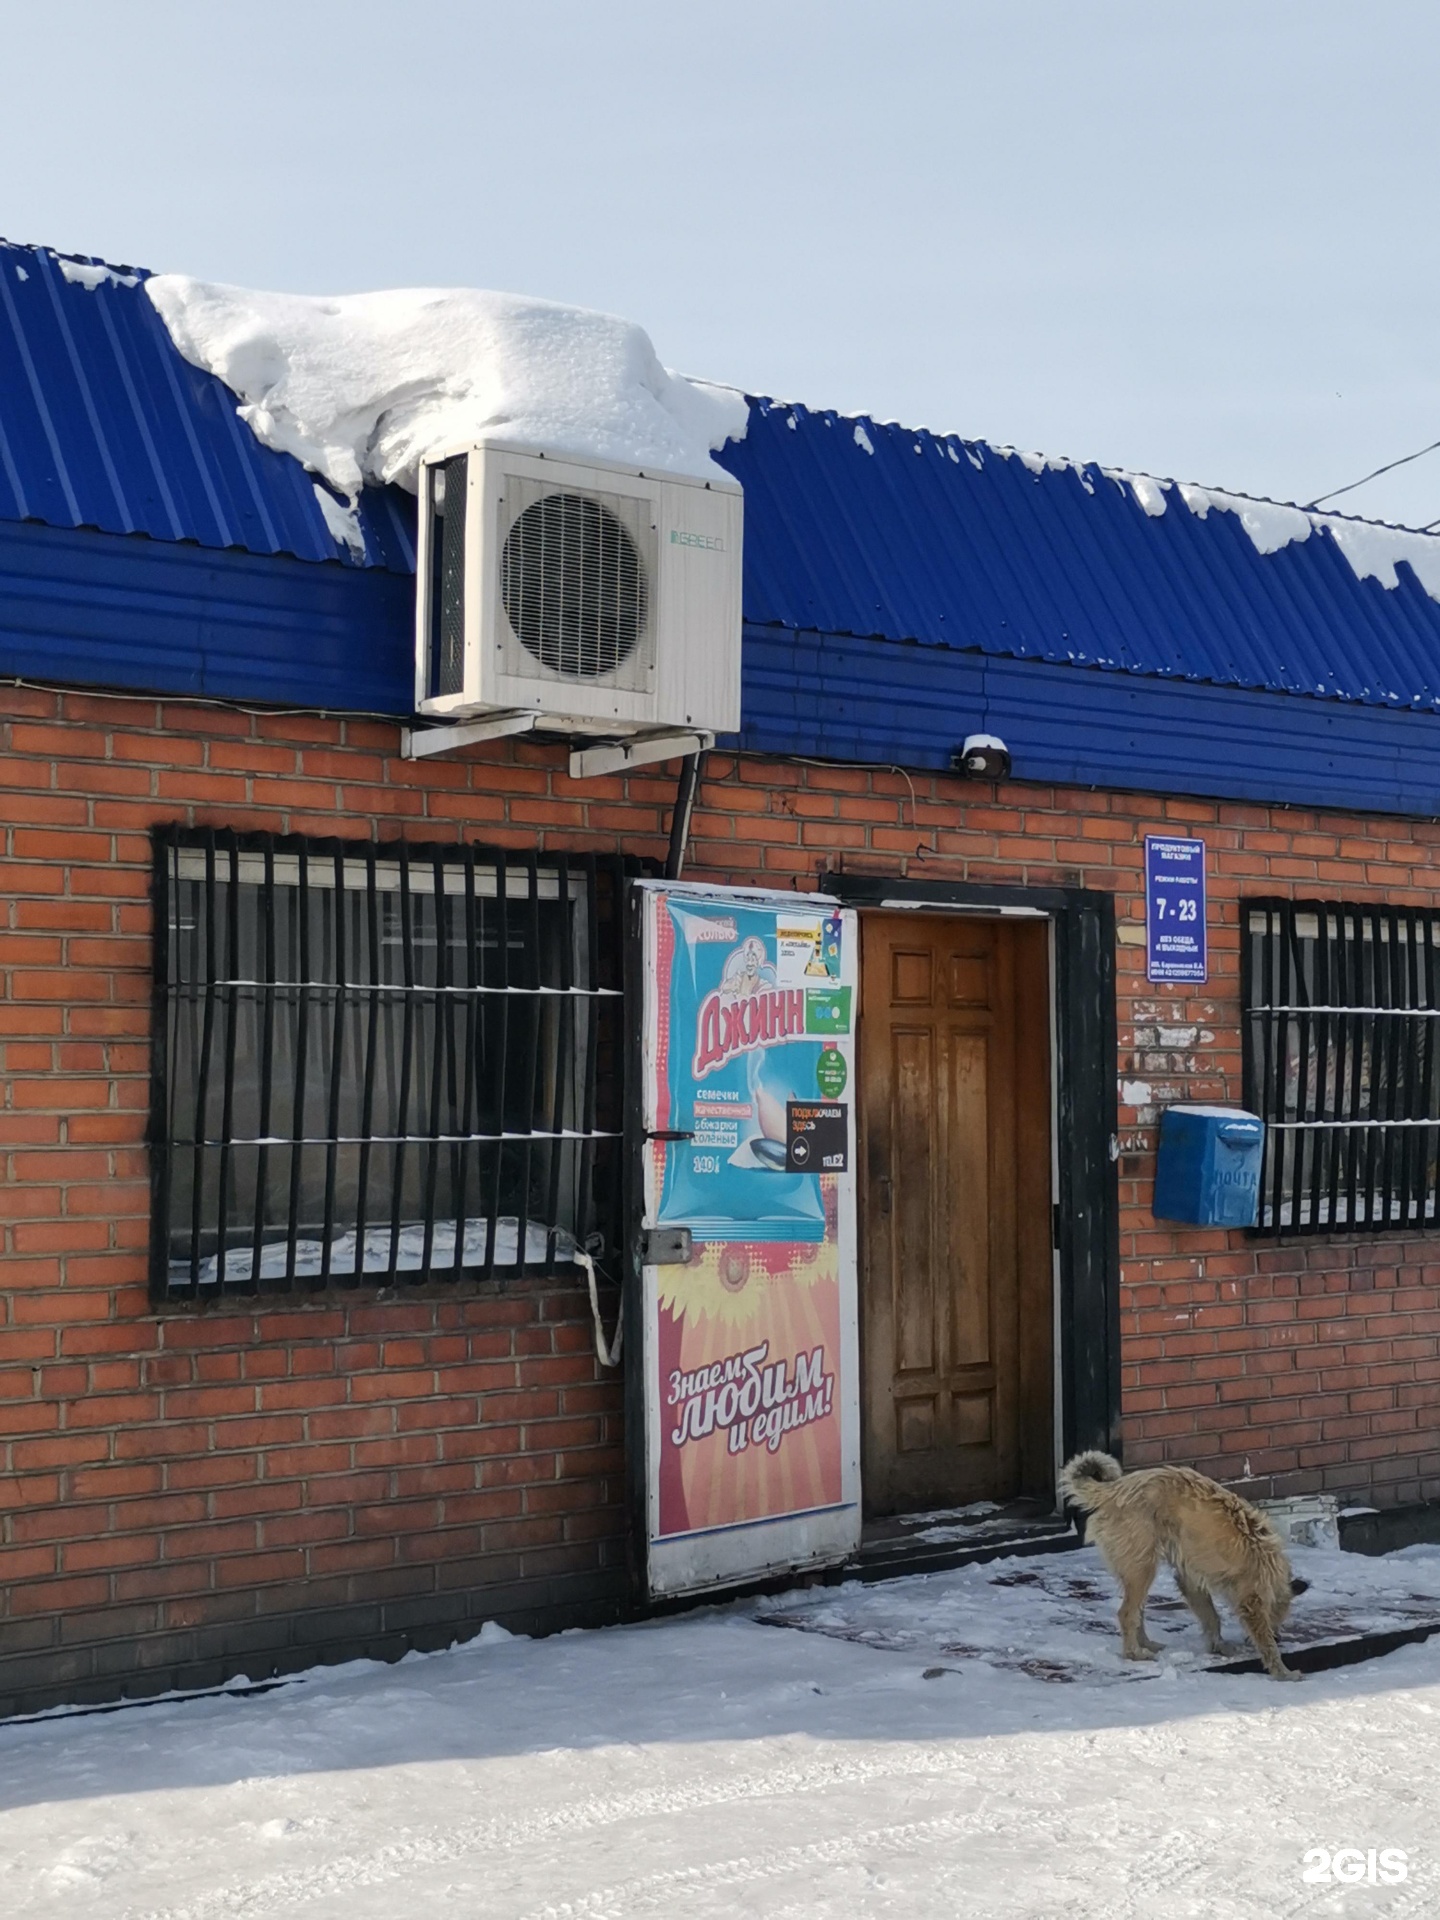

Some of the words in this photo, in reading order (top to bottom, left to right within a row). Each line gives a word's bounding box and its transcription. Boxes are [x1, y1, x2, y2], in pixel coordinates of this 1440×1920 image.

[1161, 852, 1192, 860] МАГАЗИН
[696, 1089, 740, 1101] семечки
[791, 1107, 843, 1120] ПОДКЛЮЧАЕМ
[792, 1120, 817, 1132] ЗДЕСЬ
[668, 1357, 748, 1405] Знаем,
[729, 1423, 748, 1453] и
[755, 1376, 834, 1452] едим!
